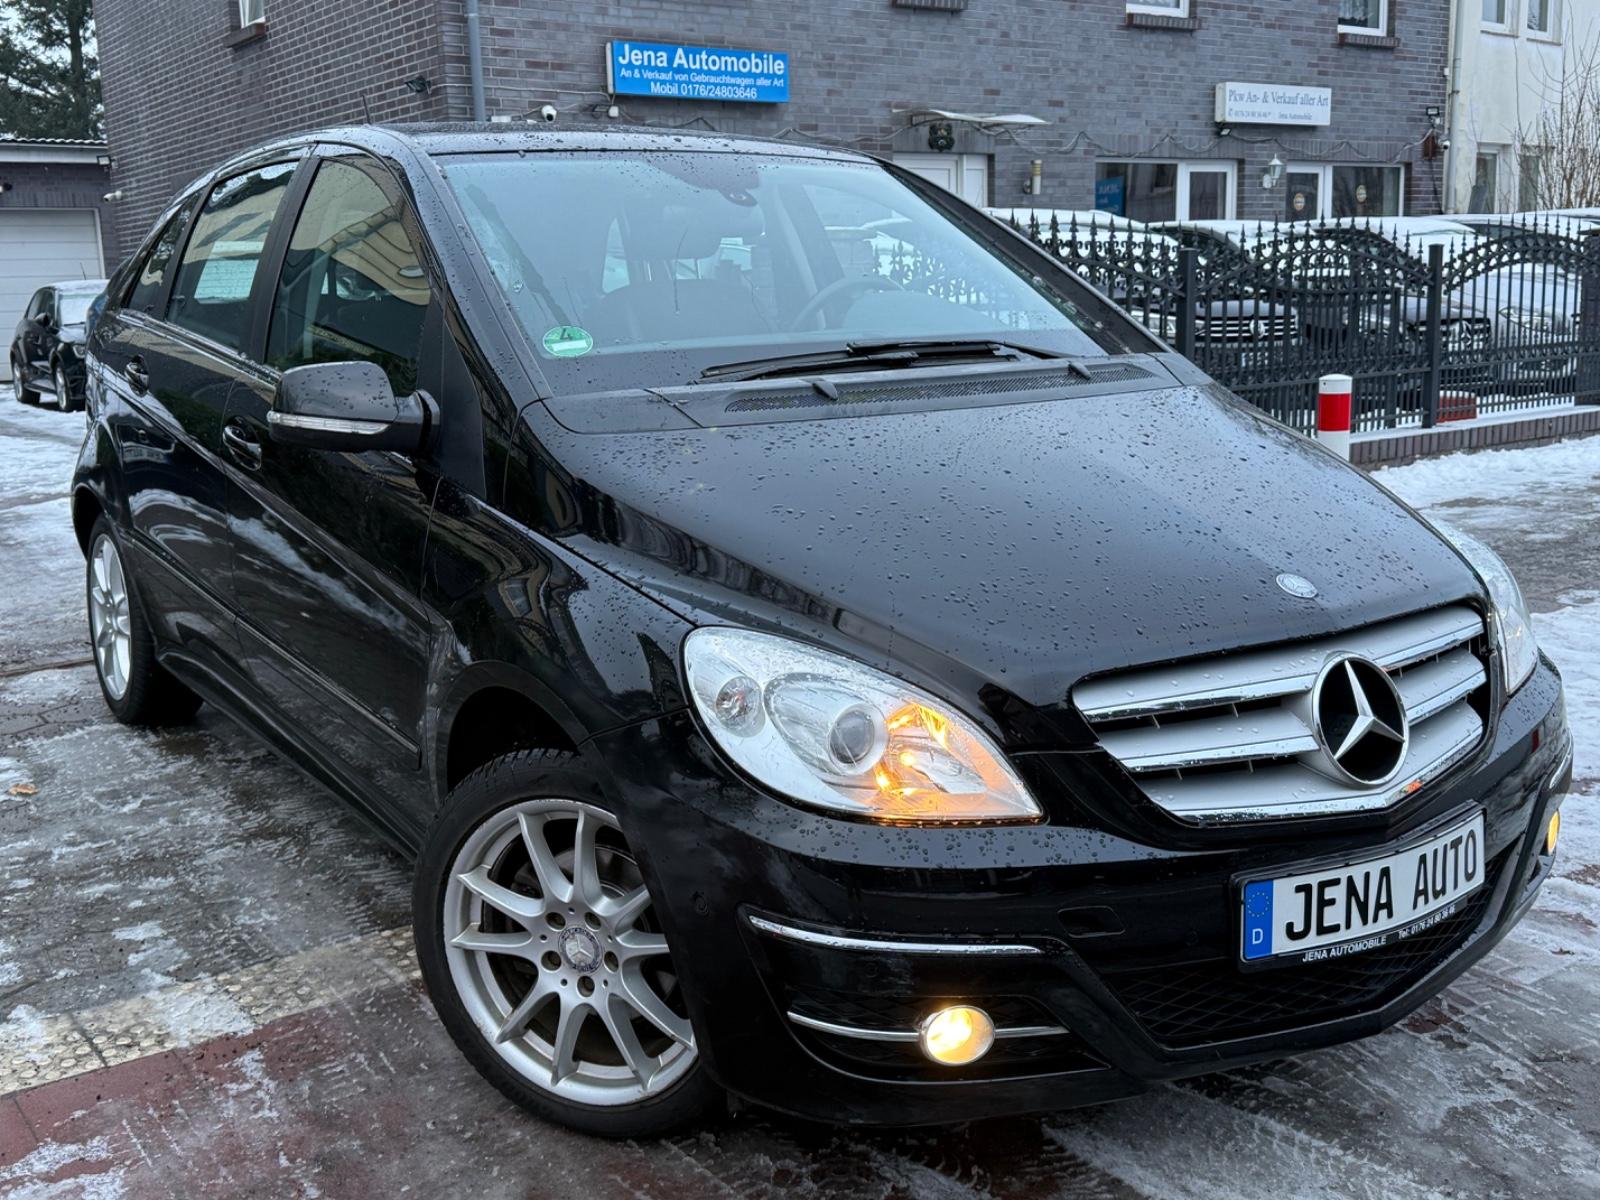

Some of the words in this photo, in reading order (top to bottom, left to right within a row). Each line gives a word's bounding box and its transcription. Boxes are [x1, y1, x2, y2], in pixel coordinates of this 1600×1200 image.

[618, 43, 668, 67] Jena
[672, 47, 785, 75] Automobile
[620, 67, 632, 78] An
[633, 69, 641, 79] &
[642, 69, 673, 81] Verkauf
[674, 74, 689, 82] von
[690, 72, 755, 87] Gebrauchtwagen
[755, 77, 772, 86] aller
[772, 77, 785, 88] Art
[650, 81, 679, 96] Mobil
[680, 83, 758, 99] 0176/24803646
[1228, 89, 1245, 102] Pkw
[1245, 91, 1260, 103] An-
[1262, 91, 1270, 104] &
[1271, 91, 1300, 105] Verkauf
[1300, 93, 1315, 106] aller
[1316, 94, 1329, 107] Art
[559, 328, 573, 341] 4
[1285, 865, 1394, 942] JENA
[1412, 828, 1477, 911] AUTO
[1252, 928, 1264, 945] D
[1302, 950, 1328, 963] JENA
[1329, 935, 1387, 958] AUTOMOBILE
